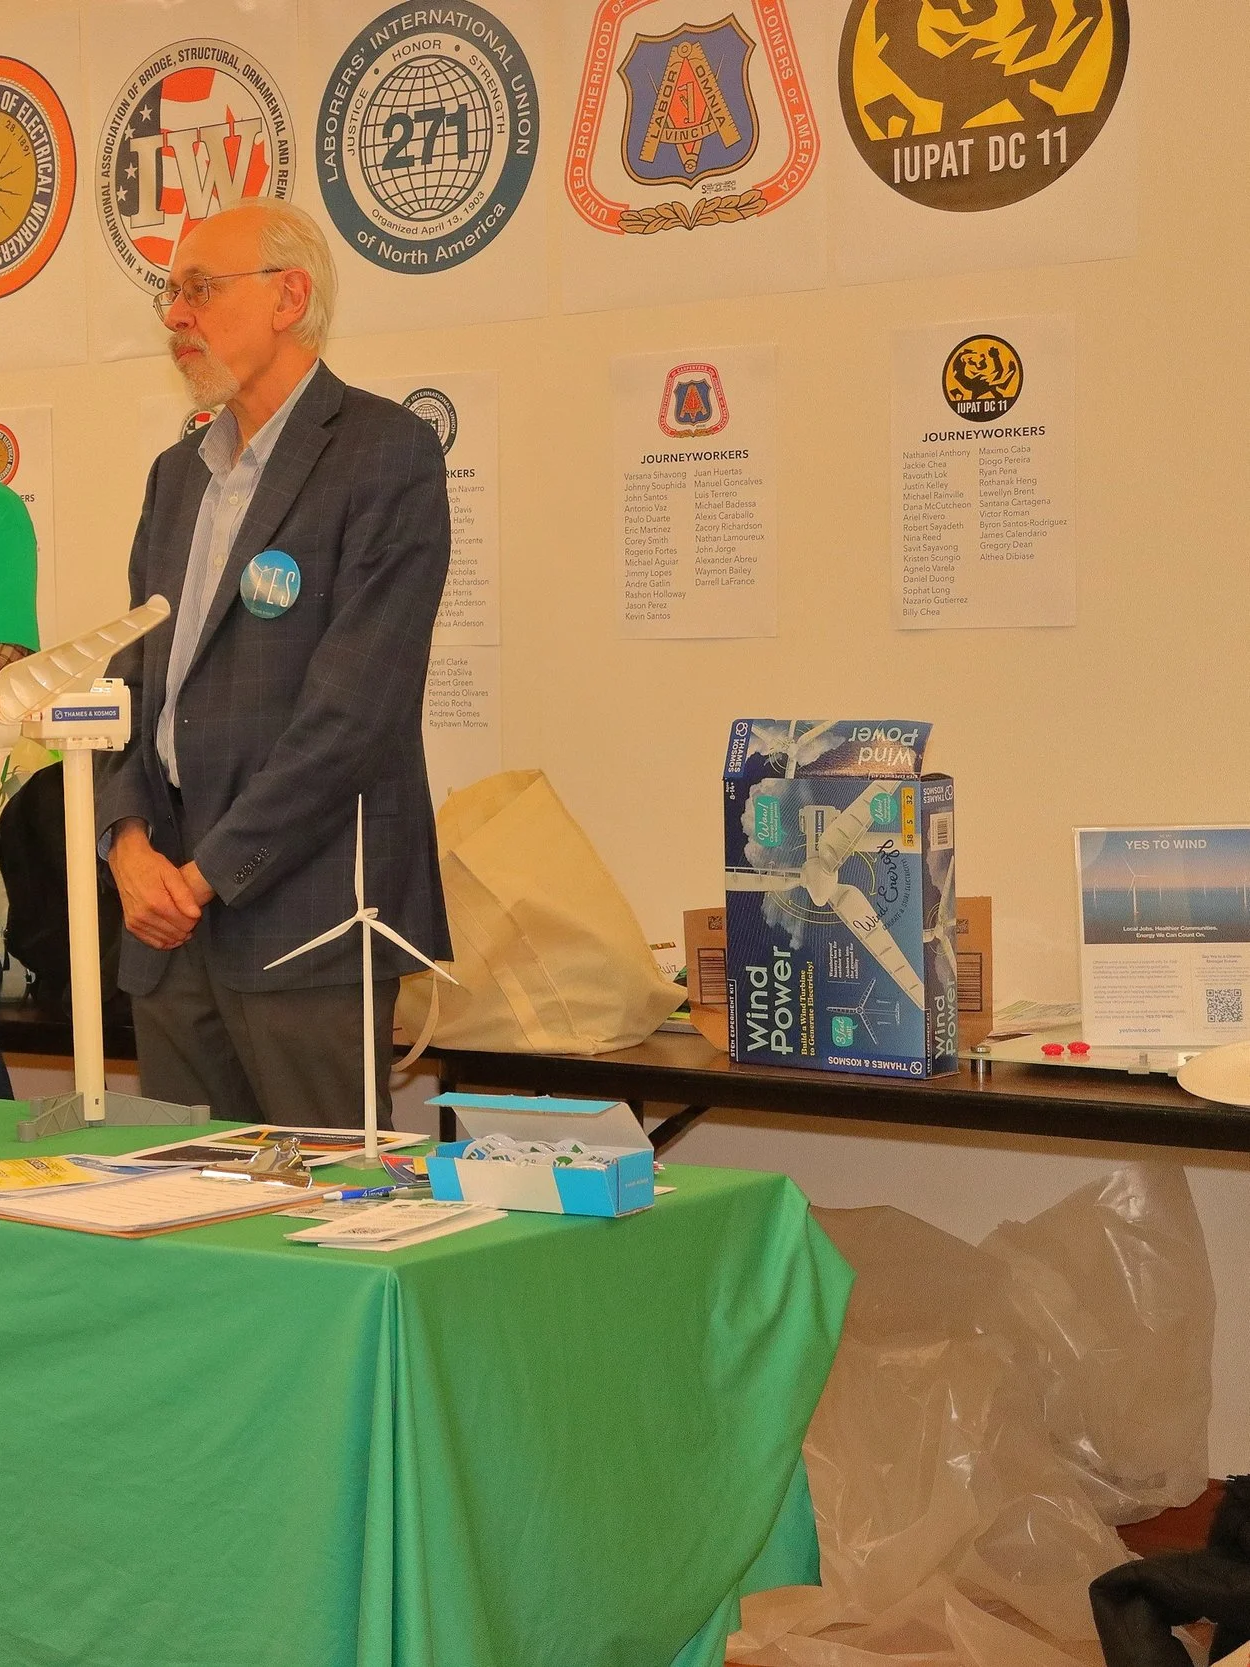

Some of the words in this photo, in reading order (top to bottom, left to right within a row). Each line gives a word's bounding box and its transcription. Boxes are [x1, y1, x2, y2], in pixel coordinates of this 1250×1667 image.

[177, 46, 242, 74] STRUCTURAL,
[763, 5, 794, 80] JOINERS
[138, 54, 178, 87] BRIDGE,
[127, 83, 140, 101] OF
[241, 62, 287, 138] ORNAMENTAL
[324, 46, 366, 183] LABORERS'
[369, 9, 516, 72] INTERNATIONAL
[510, 74, 532, 156] UNION
[346, 88, 369, 156] JUSTICE
[390, 39, 442, 62] HONOR
[468, 54, 506, 134] STRENGTH
[576, 21, 612, 160] BROTHERHOOD
[650, 69, 678, 140] LABOR
[696, 63, 726, 128] OMNIA
[788, 88, 800, 106] OF
[0, 89, 18, 114] OF
[14, 102, 53, 196] ELECTRICAL
[16, 133, 32, 158] 1891
[102, 100, 131, 179] ASSOCIATION
[382, 103, 469, 171] 271
[663, 121, 712, 141] VINCIT
[278, 138, 290, 166] AND
[778, 112, 810, 193] AMERICA
[894, 138, 974, 184] IUPAT
[988, 132, 1026, 172] DC
[1037, 126, 1068, 166] 11
[130, 117, 262, 229] IW
[572, 166, 608, 222] UNITED
[102, 181, 137, 269] INTERNATIONAL
[372, 208, 418, 235] Organized
[421, 222, 446, 236] April
[463, 190, 486, 216] 1903
[356, 230, 373, 250] of
[378, 241, 428, 264] North
[434, 202, 507, 262] America
[957, 400, 982, 414] IUPAT
[984, 401, 996, 413] DC
[998, 400, 1008, 412] 11
[922, 426, 1046, 443] JOURNEYWORKERS
[640, 450, 750, 465] JOURNEYWORKERS
[714, 468, 742, 476] Huertas
[978, 457, 1003, 466] Diogo
[1004, 456, 1030, 464] Pereira
[694, 501, 724, 510] Michael
[725, 500, 756, 508] Badessa
[695, 524, 720, 533] Zacory
[722, 522, 762, 532] Richardson
[980, 542, 1011, 551] Gregory
[1012, 540, 1033, 549] Dean
[64, 710, 88, 718] THAMES
[429, 710, 454, 718] Andrew
[456, 710, 480, 718] Gomes
[848, 726, 919, 747] Power
[728, 738, 738, 773] KOSMOS
[734, 738, 746, 773] THAMES
[858, 746, 913, 766] Wind
[1125, 840, 1150, 850] YES
[1152, 840, 1170, 850] TO
[1172, 839, 1208, 850] WIND
[876, 839, 900, 903] Energy
[770, 945, 794, 1056] Power
[806, 960, 814, 1006] Electricity!
[744, 965, 770, 1052] Wind
[946, 980, 956, 1056] Power
[934, 995, 946, 1060] Wind
[828, 1056, 862, 1067] KOSMOS
[872, 1060, 908, 1072] THAMES
